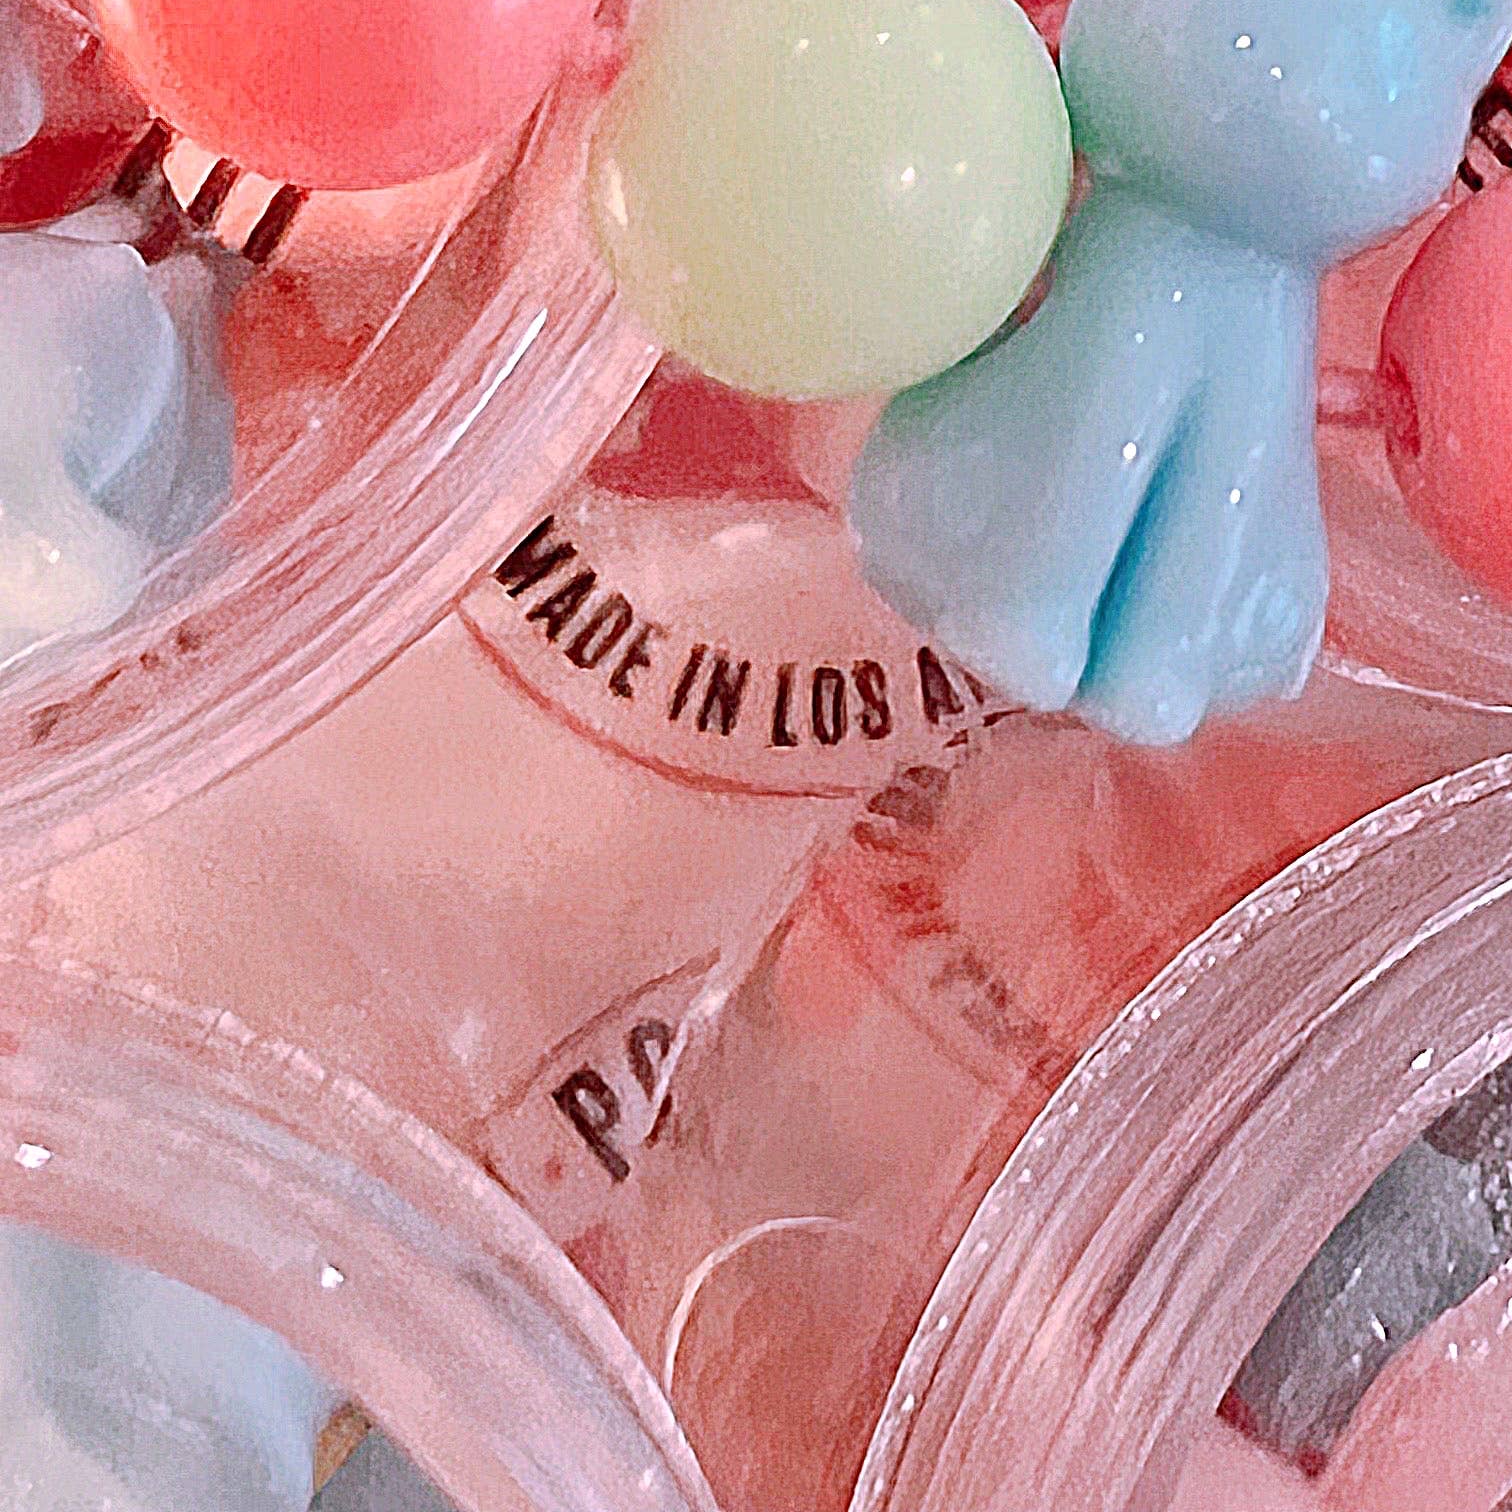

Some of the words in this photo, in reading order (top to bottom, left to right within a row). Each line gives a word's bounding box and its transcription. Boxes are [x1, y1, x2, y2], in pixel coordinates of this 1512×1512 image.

[495, 514, 660, 700] MADE
[668, 642, 750, 737] IN
[766, 658, 892, 750] LOS
